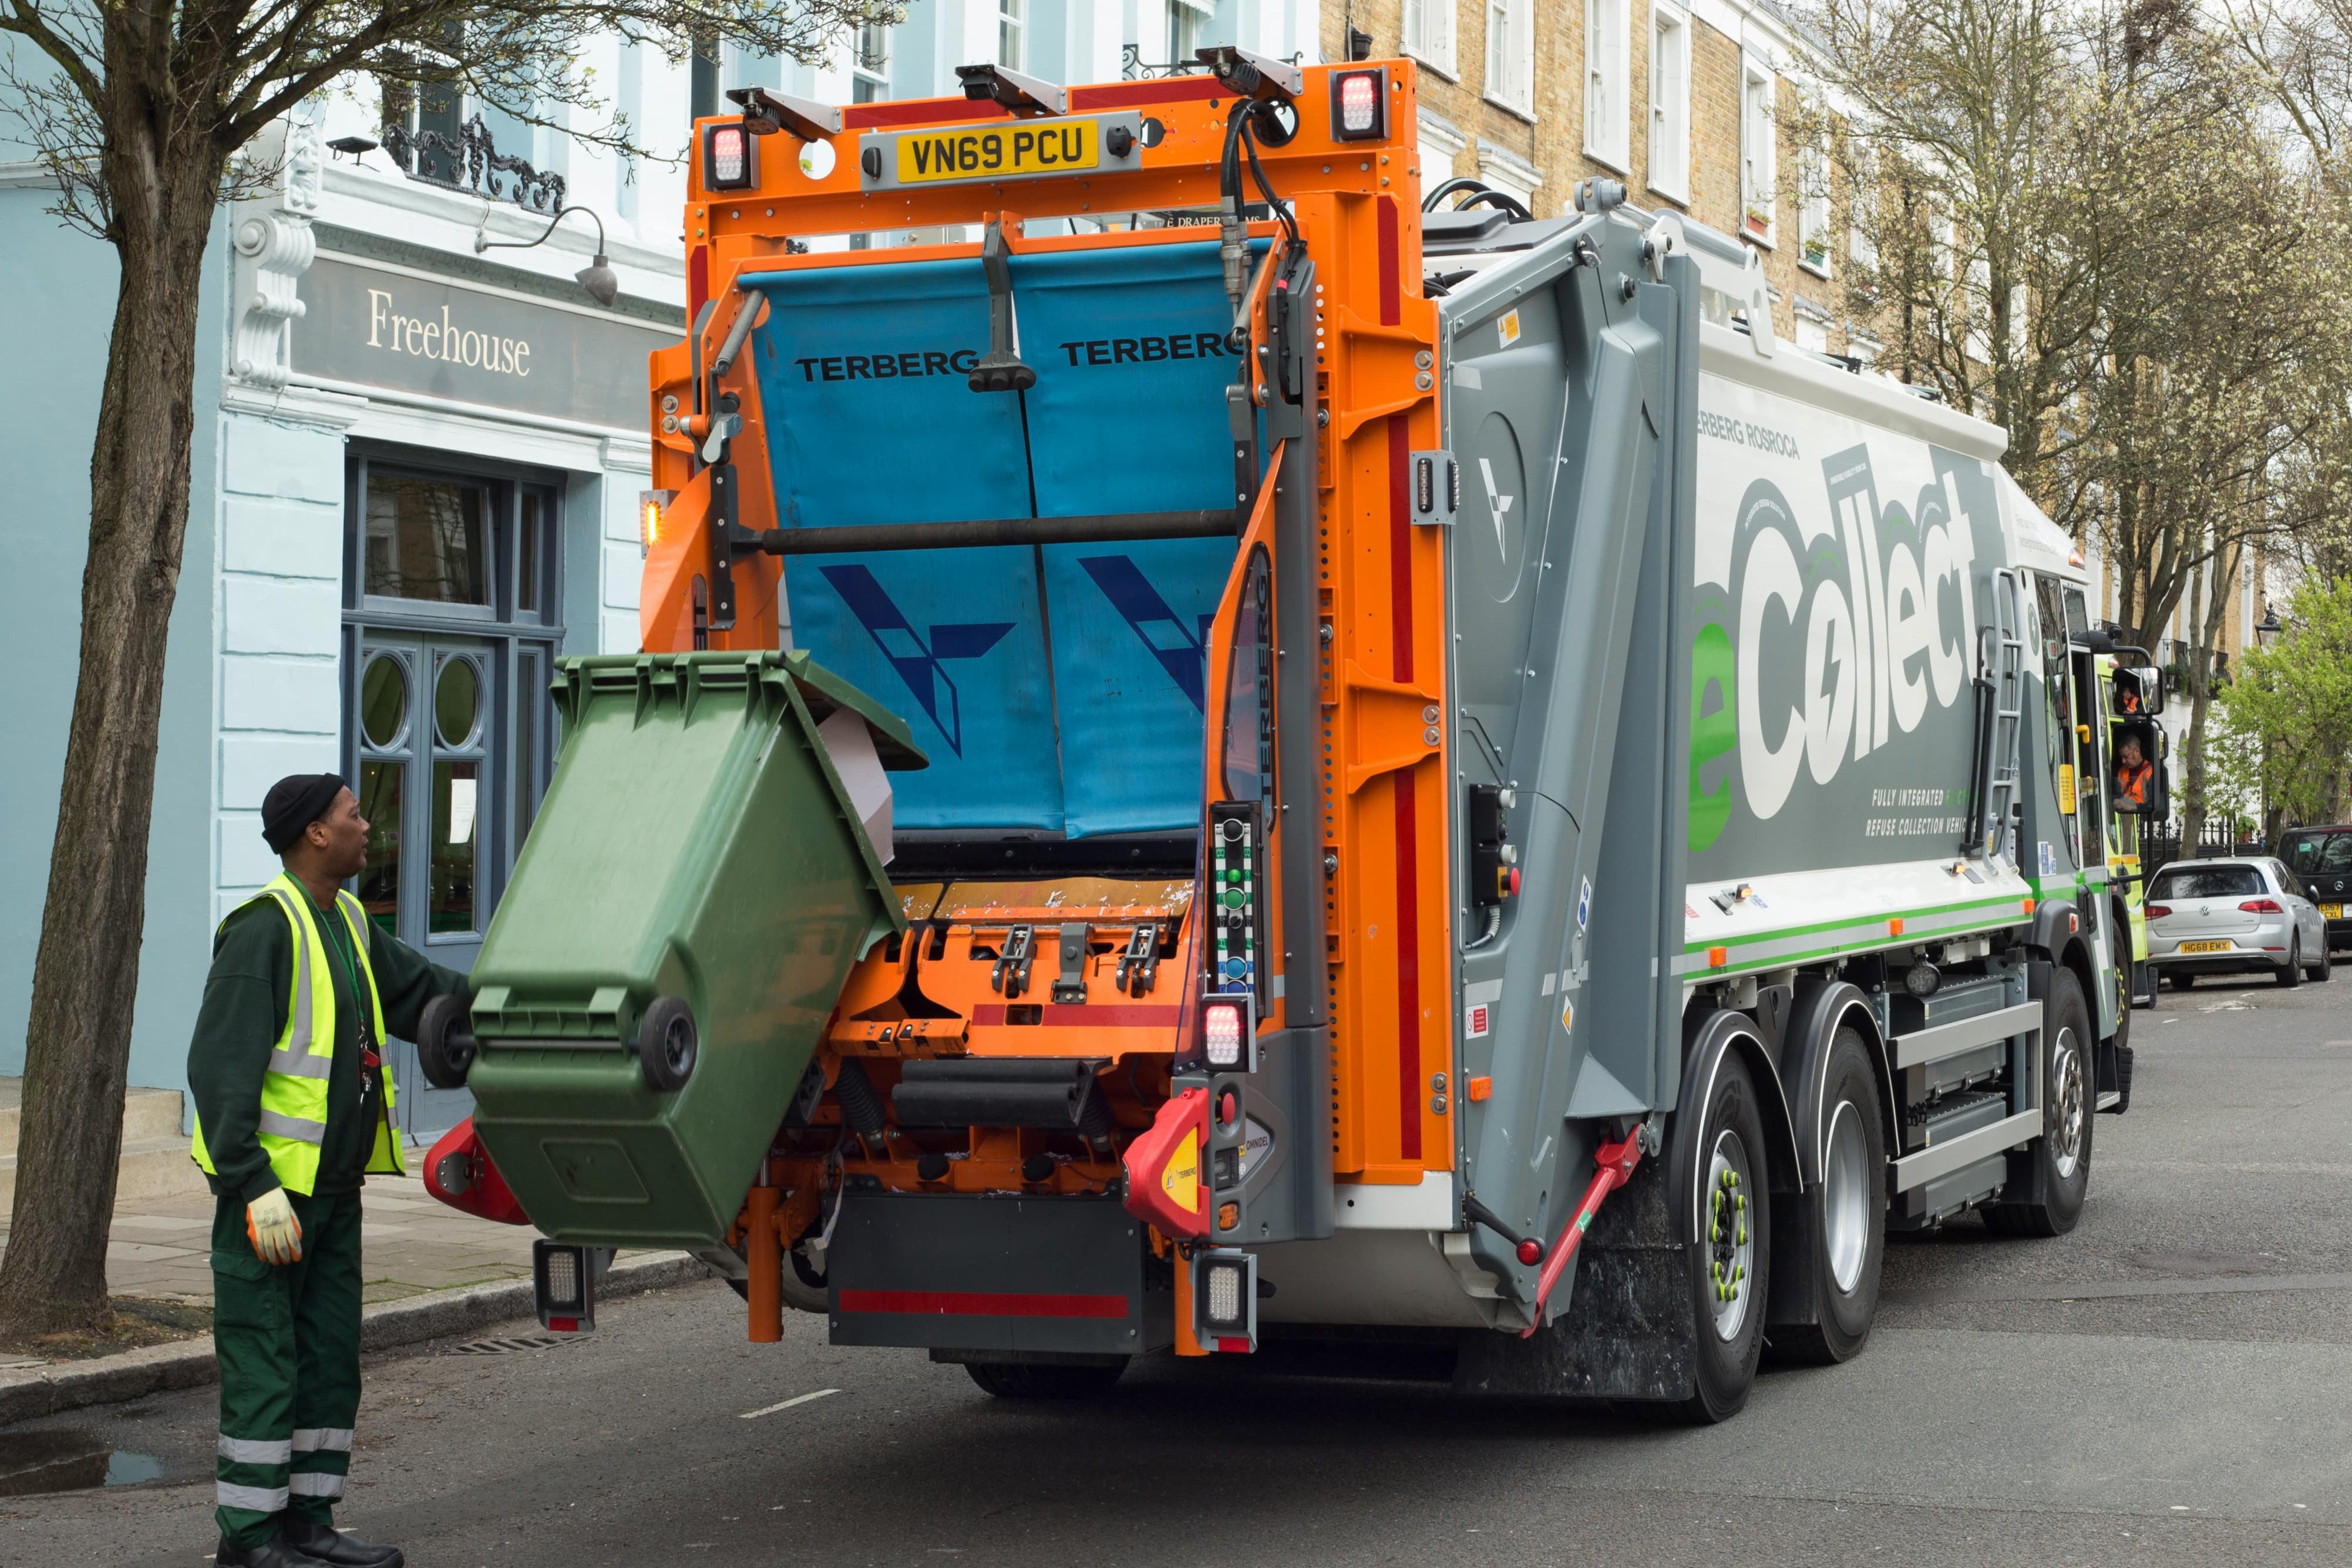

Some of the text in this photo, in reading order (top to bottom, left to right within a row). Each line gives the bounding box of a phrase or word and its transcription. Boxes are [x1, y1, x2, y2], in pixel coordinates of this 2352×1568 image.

[912, 127, 1082, 174] VN69 PCU
[1178, 216, 1221, 227] DRAPER
[366, 288, 530, 377] Freehouse
[794, 349, 980, 382] TERBERG
[1697, 409, 1801, 460] ERBERG ROSROCA
[1257, 574, 1272, 801] TERBERG
[1872, 789, 1896, 807] FULLY
[1898, 789, 1944, 806] INTEGRATED
[1865, 817, 1896, 837] REFUSE
[1898, 817, 1944, 836] COLLECTION
[2185, 941, 2227, 952] HG68 EMX
[1246, 1136, 1268, 1150] OMNIDEL
[1179, 1166, 1196, 1179] TERBERG
